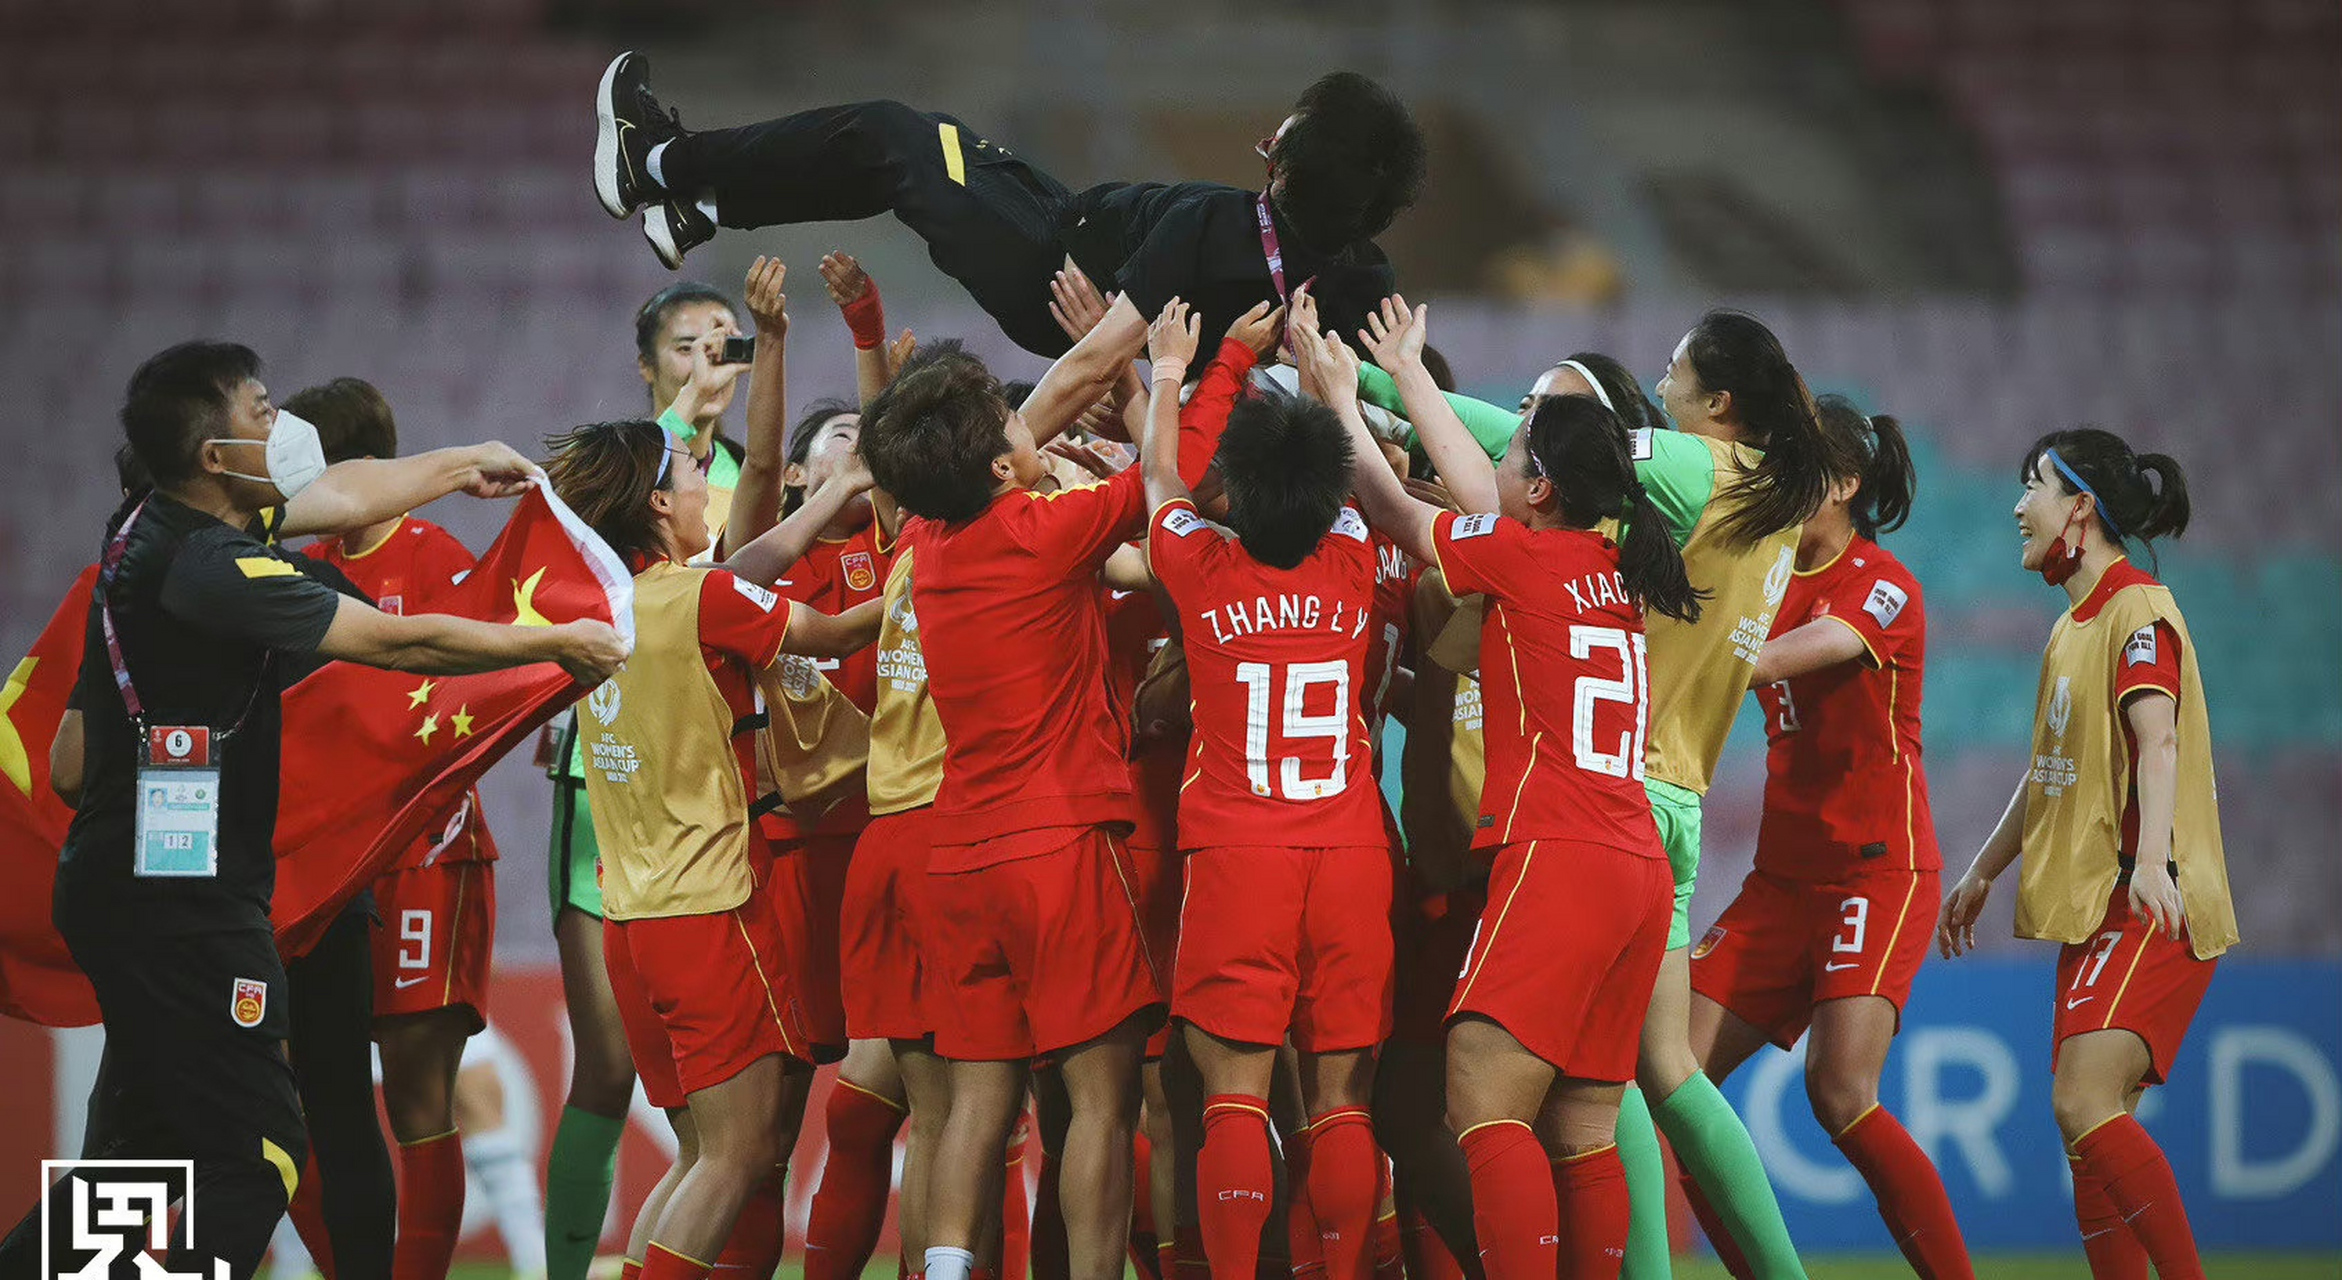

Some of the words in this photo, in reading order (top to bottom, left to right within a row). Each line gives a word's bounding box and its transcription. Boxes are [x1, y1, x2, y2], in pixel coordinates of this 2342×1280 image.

[1201, 594, 1321, 645] ZHANG
[174, 734, 183, 748] 6
[1236, 659, 1351, 799] 19
[399, 909, 433, 969] 9
[1832, 896, 1869, 954] 3
[2070, 930, 2124, 989] 17
[1742, 1024, 2341, 1200] CRD
[1218, 1190, 1265, 1201] CFA
